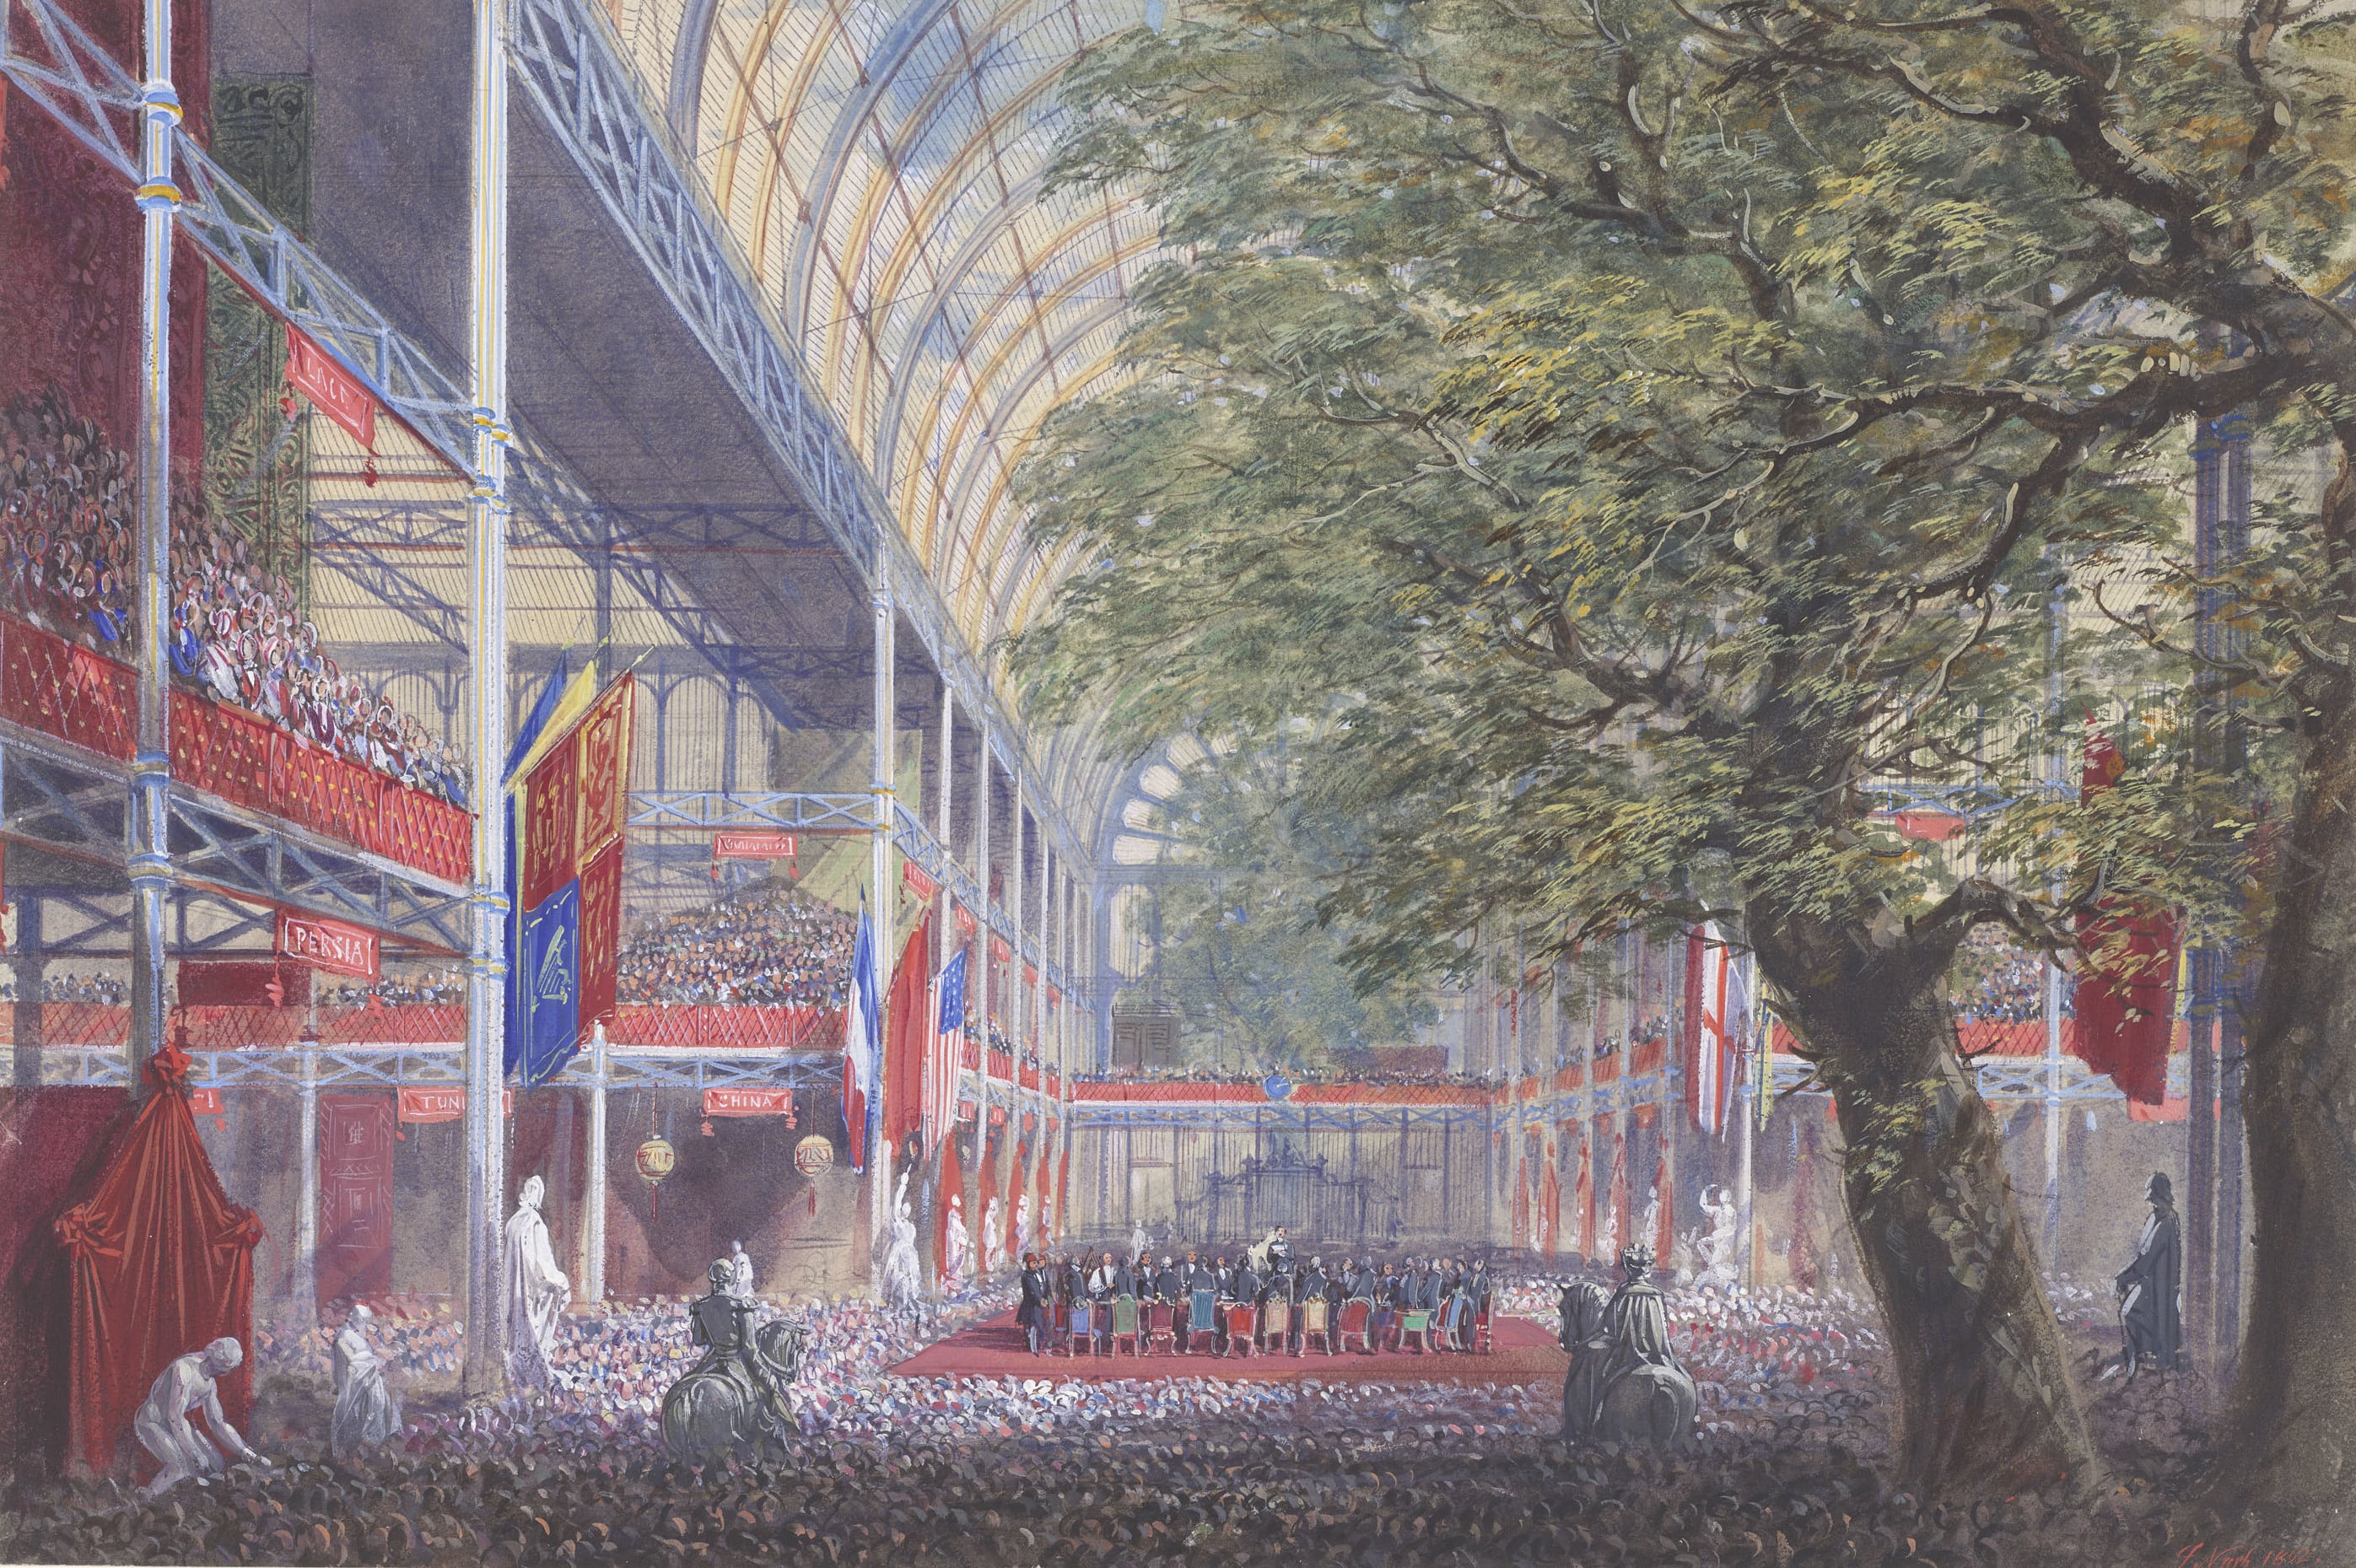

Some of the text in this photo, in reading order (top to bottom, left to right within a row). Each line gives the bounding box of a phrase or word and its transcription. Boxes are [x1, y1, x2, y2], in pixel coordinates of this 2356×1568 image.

[295, 926, 364, 966] PERSIA
[420, 1096, 466, 1111] TUNI
[719, 1094, 773, 1108] CHINA
